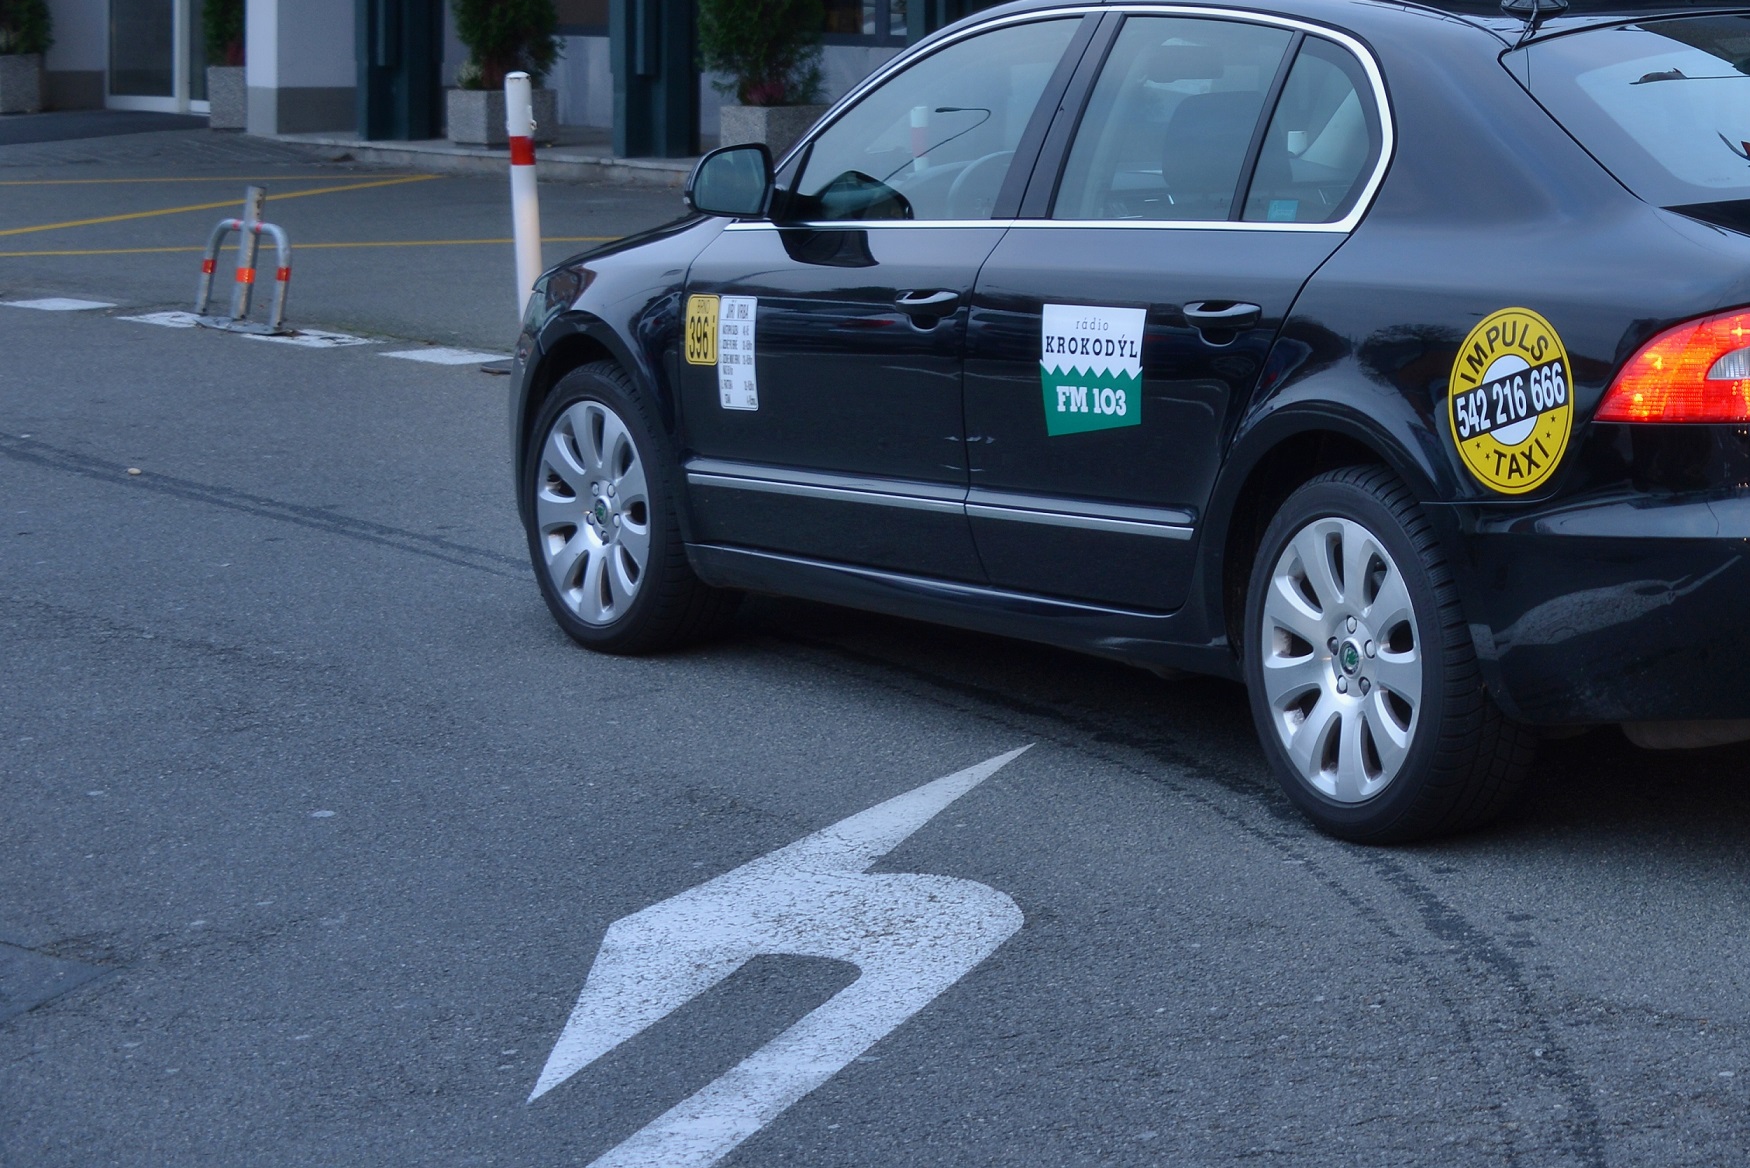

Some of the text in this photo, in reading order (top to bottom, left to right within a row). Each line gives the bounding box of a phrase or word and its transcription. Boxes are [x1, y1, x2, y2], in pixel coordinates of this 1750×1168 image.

[1076, 317, 1109, 331] rádio
[1045, 334, 1138, 358] KROKODÝL
[1460, 320, 1549, 385] IMPULS
[1056, 385, 1127, 416] FM 103
[1456, 361, 1566, 438] 542 216 666
[1493, 437, 1550, 480] TAXI
